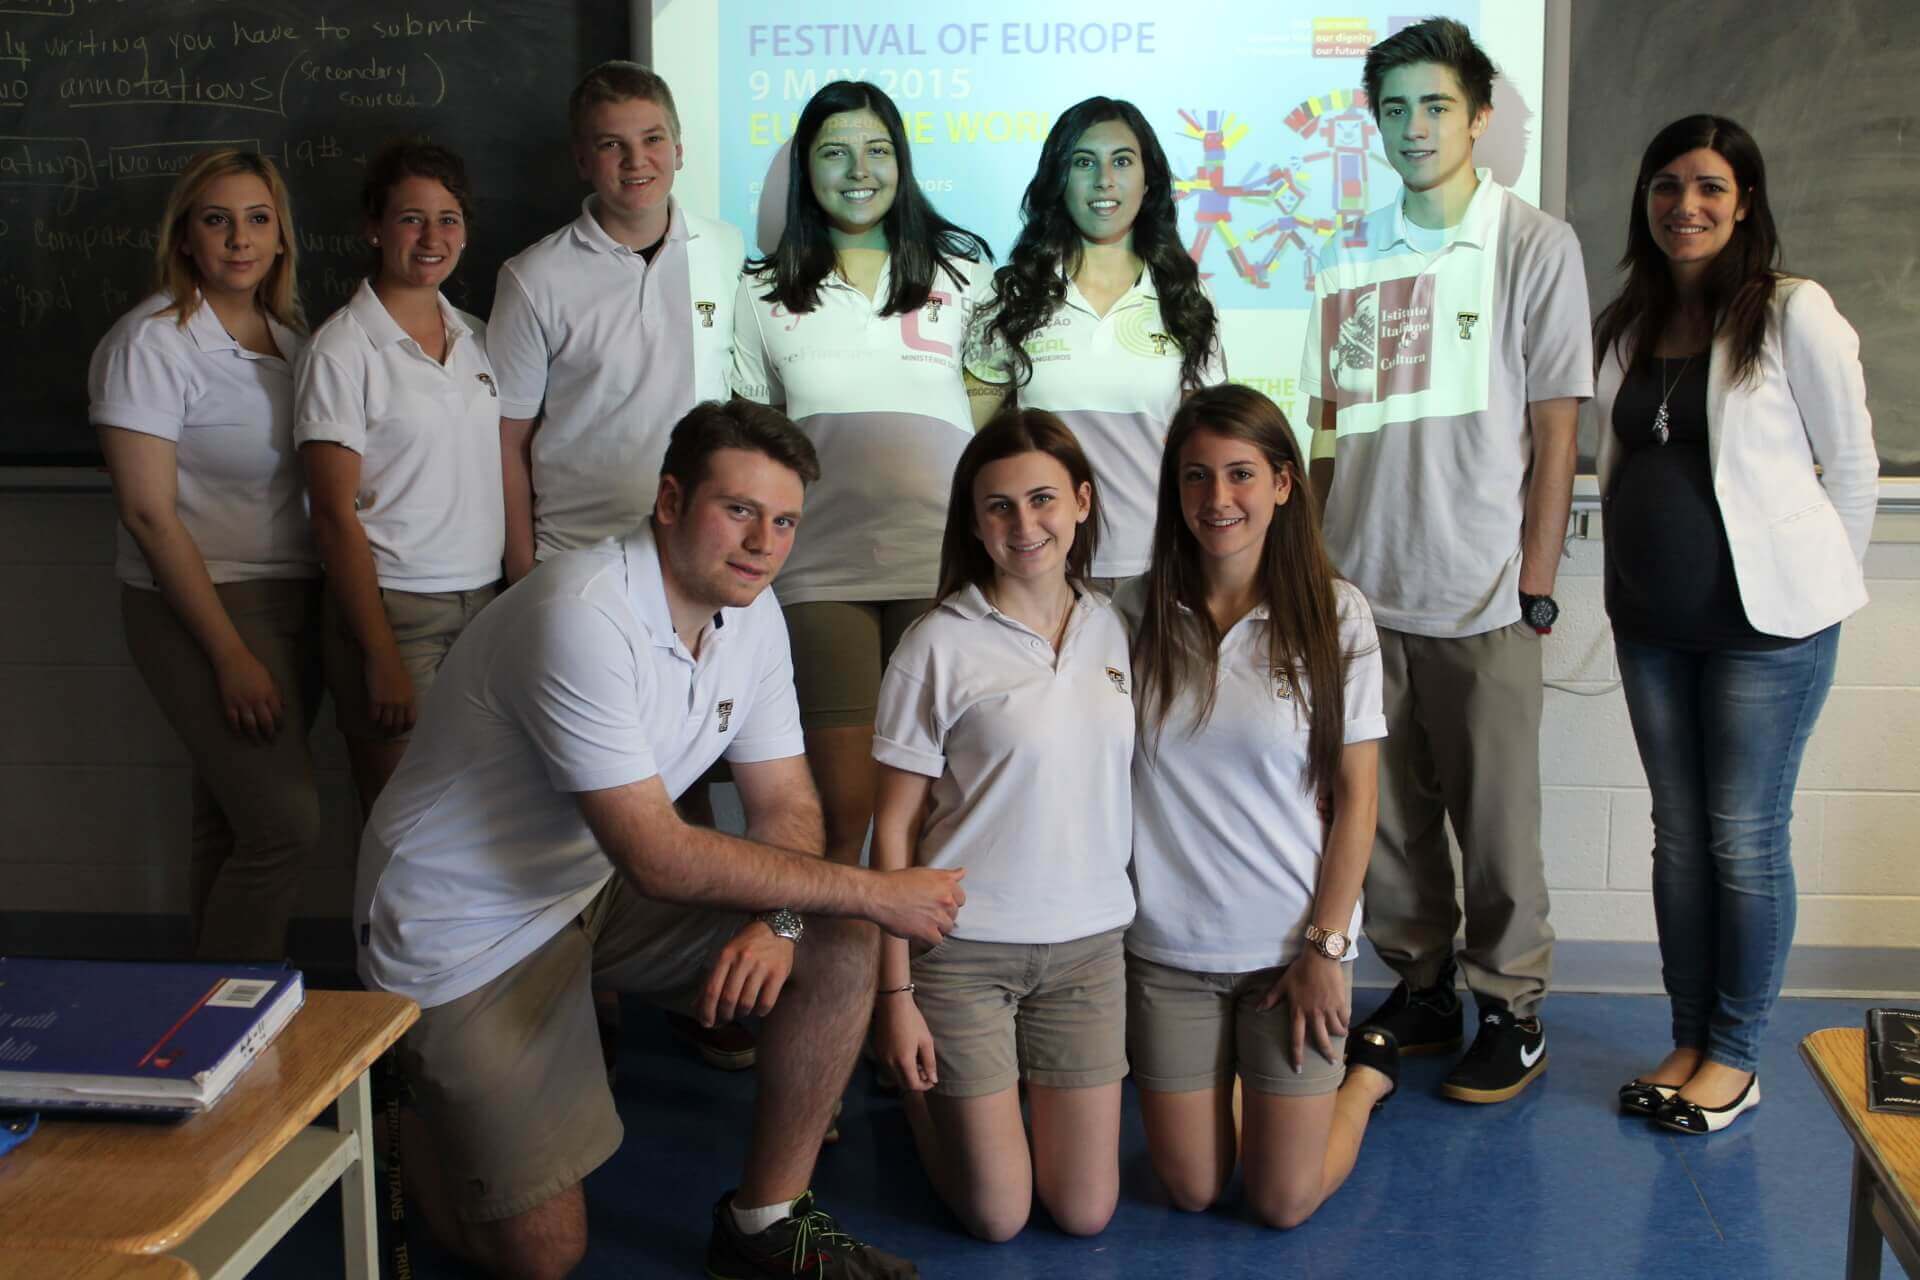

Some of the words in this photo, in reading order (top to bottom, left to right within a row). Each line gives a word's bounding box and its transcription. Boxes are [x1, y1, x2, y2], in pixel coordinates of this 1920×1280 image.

[44, 28, 150, 82] writing
[169, 33, 215, 60] you
[233, 20, 300, 47] have
[315, 16, 351, 41] to
[371, 9, 487, 40] submit
[749, 24, 927, 57] FESTIVAL
[937, 23, 989, 55] OF
[1001, 21, 1156, 54] EUROPE
[1315, 34, 1333, 43] our
[1335, 31, 1373, 45] dignity
[1315, 46, 1333, 56] our
[1335, 45, 1369, 56] future
[749, 69, 770, 101] 9
[880, 67, 973, 100] 2015
[1381, 307, 1428, 322] Istituto
[1381, 322, 1430, 338] Italiano
[1380, 353, 1426, 371] Cultura
